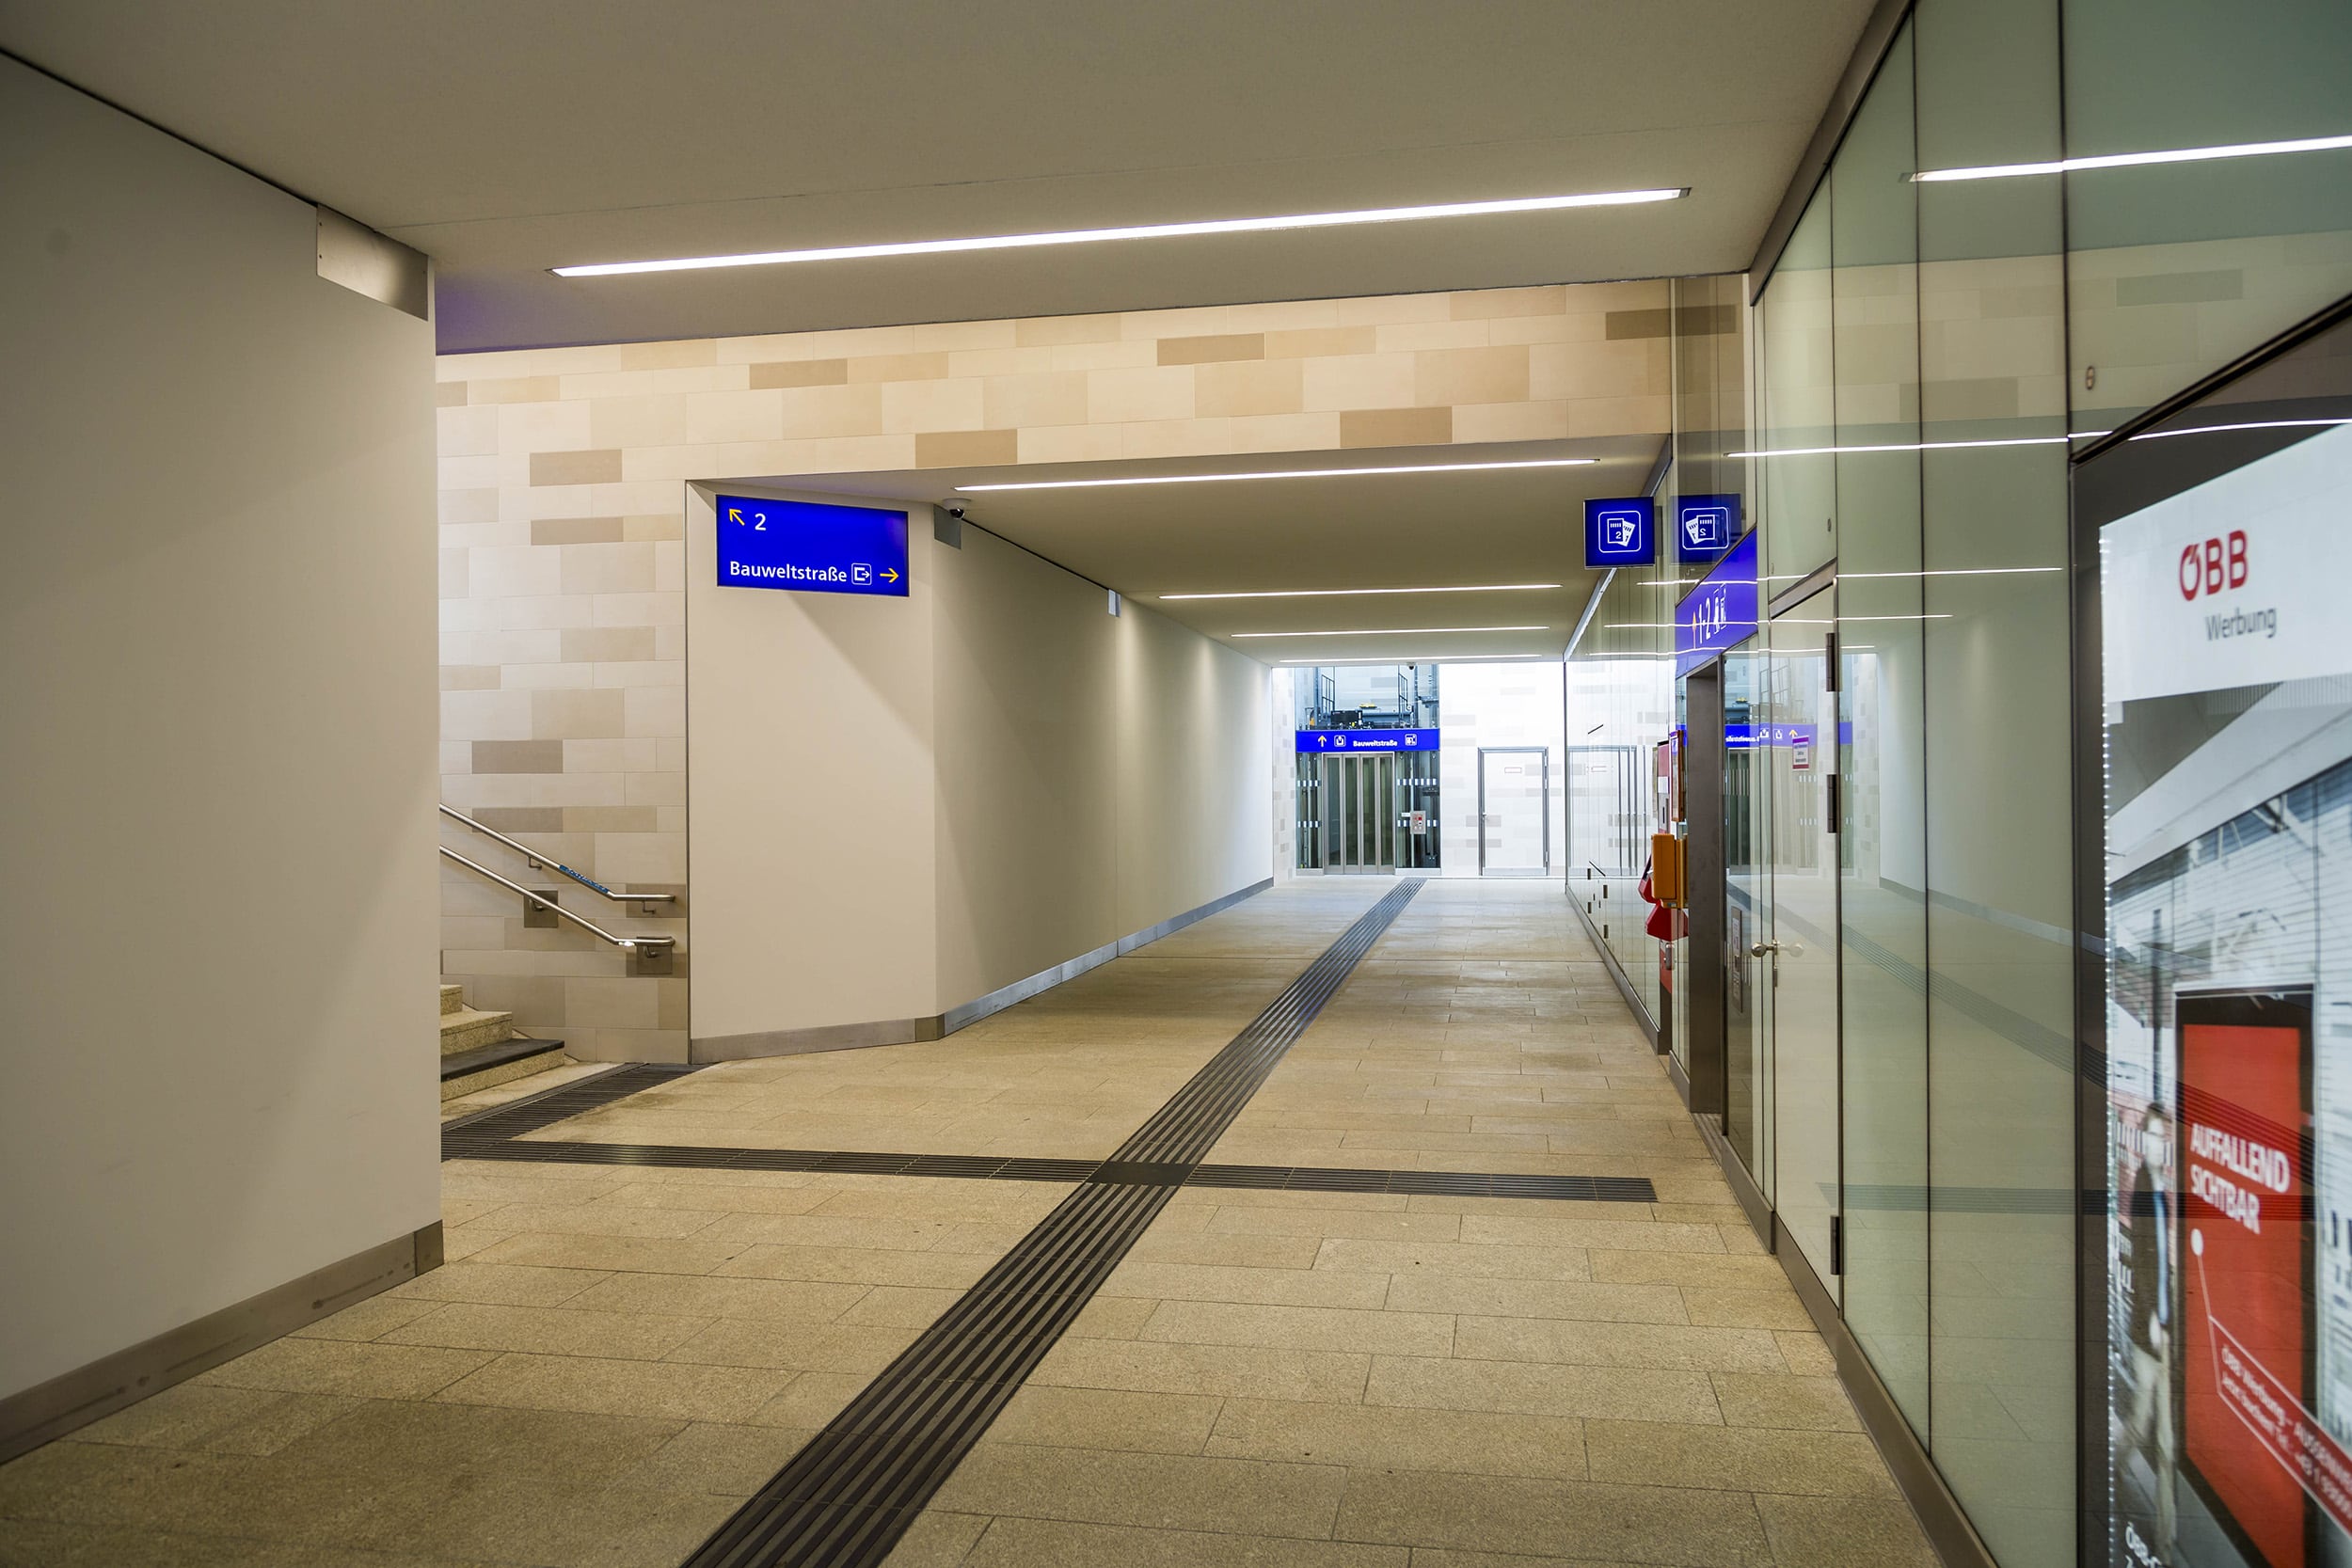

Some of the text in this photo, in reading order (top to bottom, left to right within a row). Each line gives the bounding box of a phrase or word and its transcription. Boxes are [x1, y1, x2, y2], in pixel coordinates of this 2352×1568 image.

[755, 513, 767, 531] 2
[729, 561, 848, 582] Bauweltstraße
[2179, 529, 2249, 601] ÖBB
[2205, 607, 2278, 641] Werbung
[2190, 1122, 2291, 1194] AUFFALLEND
[2190, 1164, 2261, 1235] SICHTBAR
